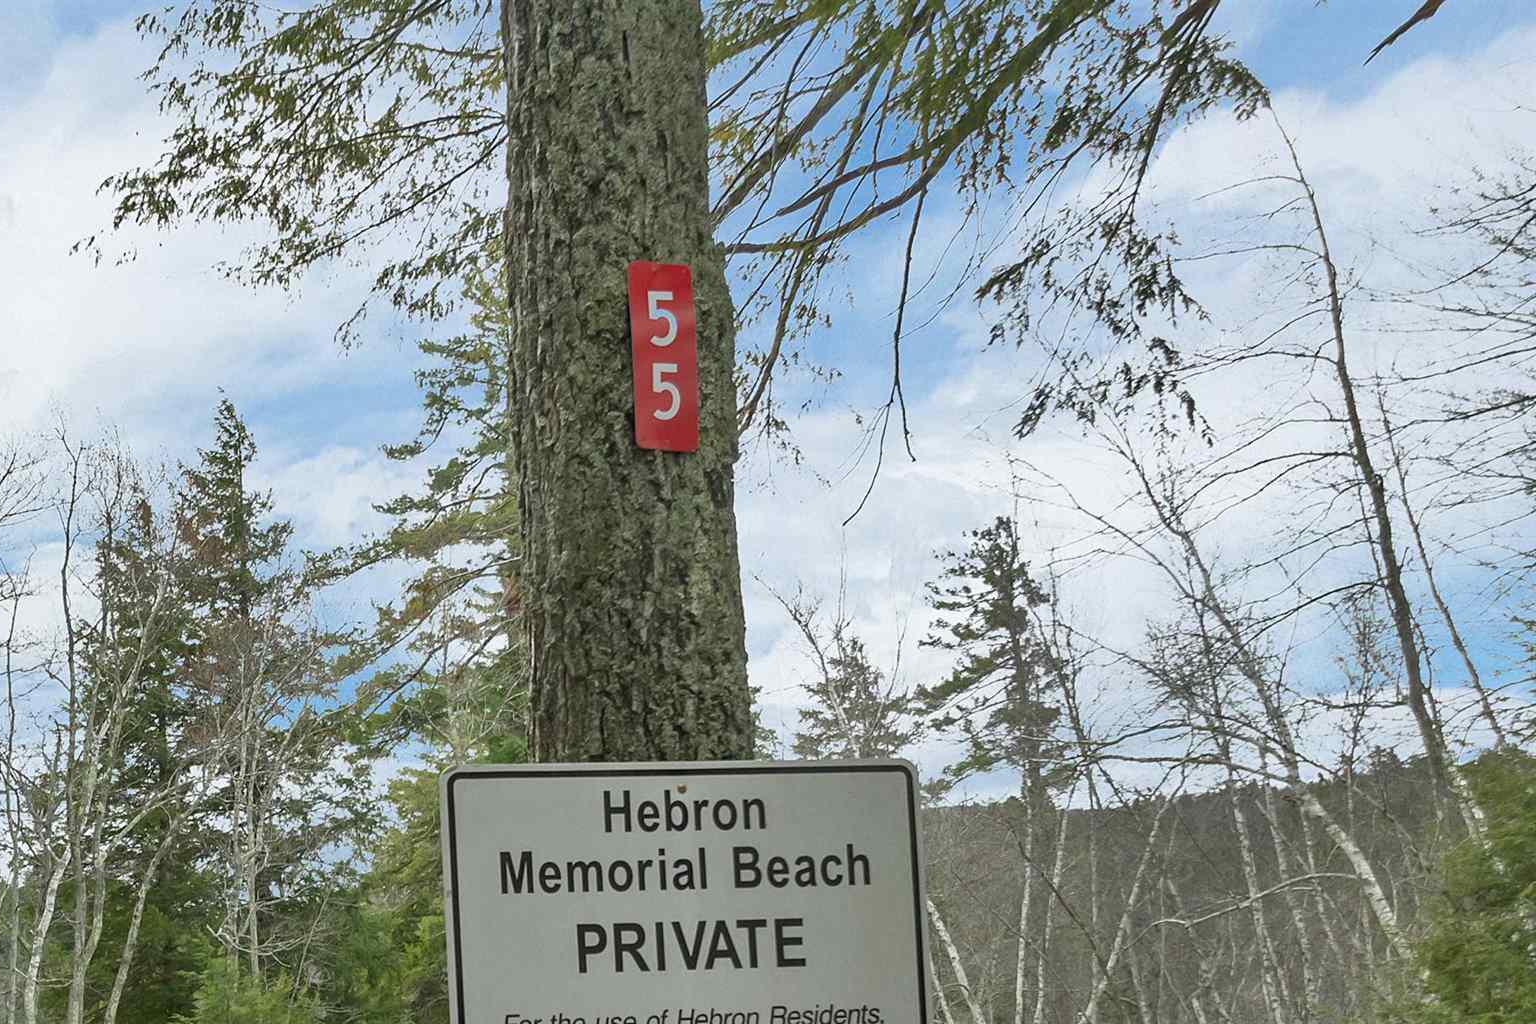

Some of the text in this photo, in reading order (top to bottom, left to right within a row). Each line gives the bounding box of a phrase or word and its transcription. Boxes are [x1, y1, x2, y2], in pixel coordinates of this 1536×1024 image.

[602, 789, 767, 833] Hebron
[499, 843, 872, 895] Memorial Beach
[576, 917, 807, 974] PRIVATE
